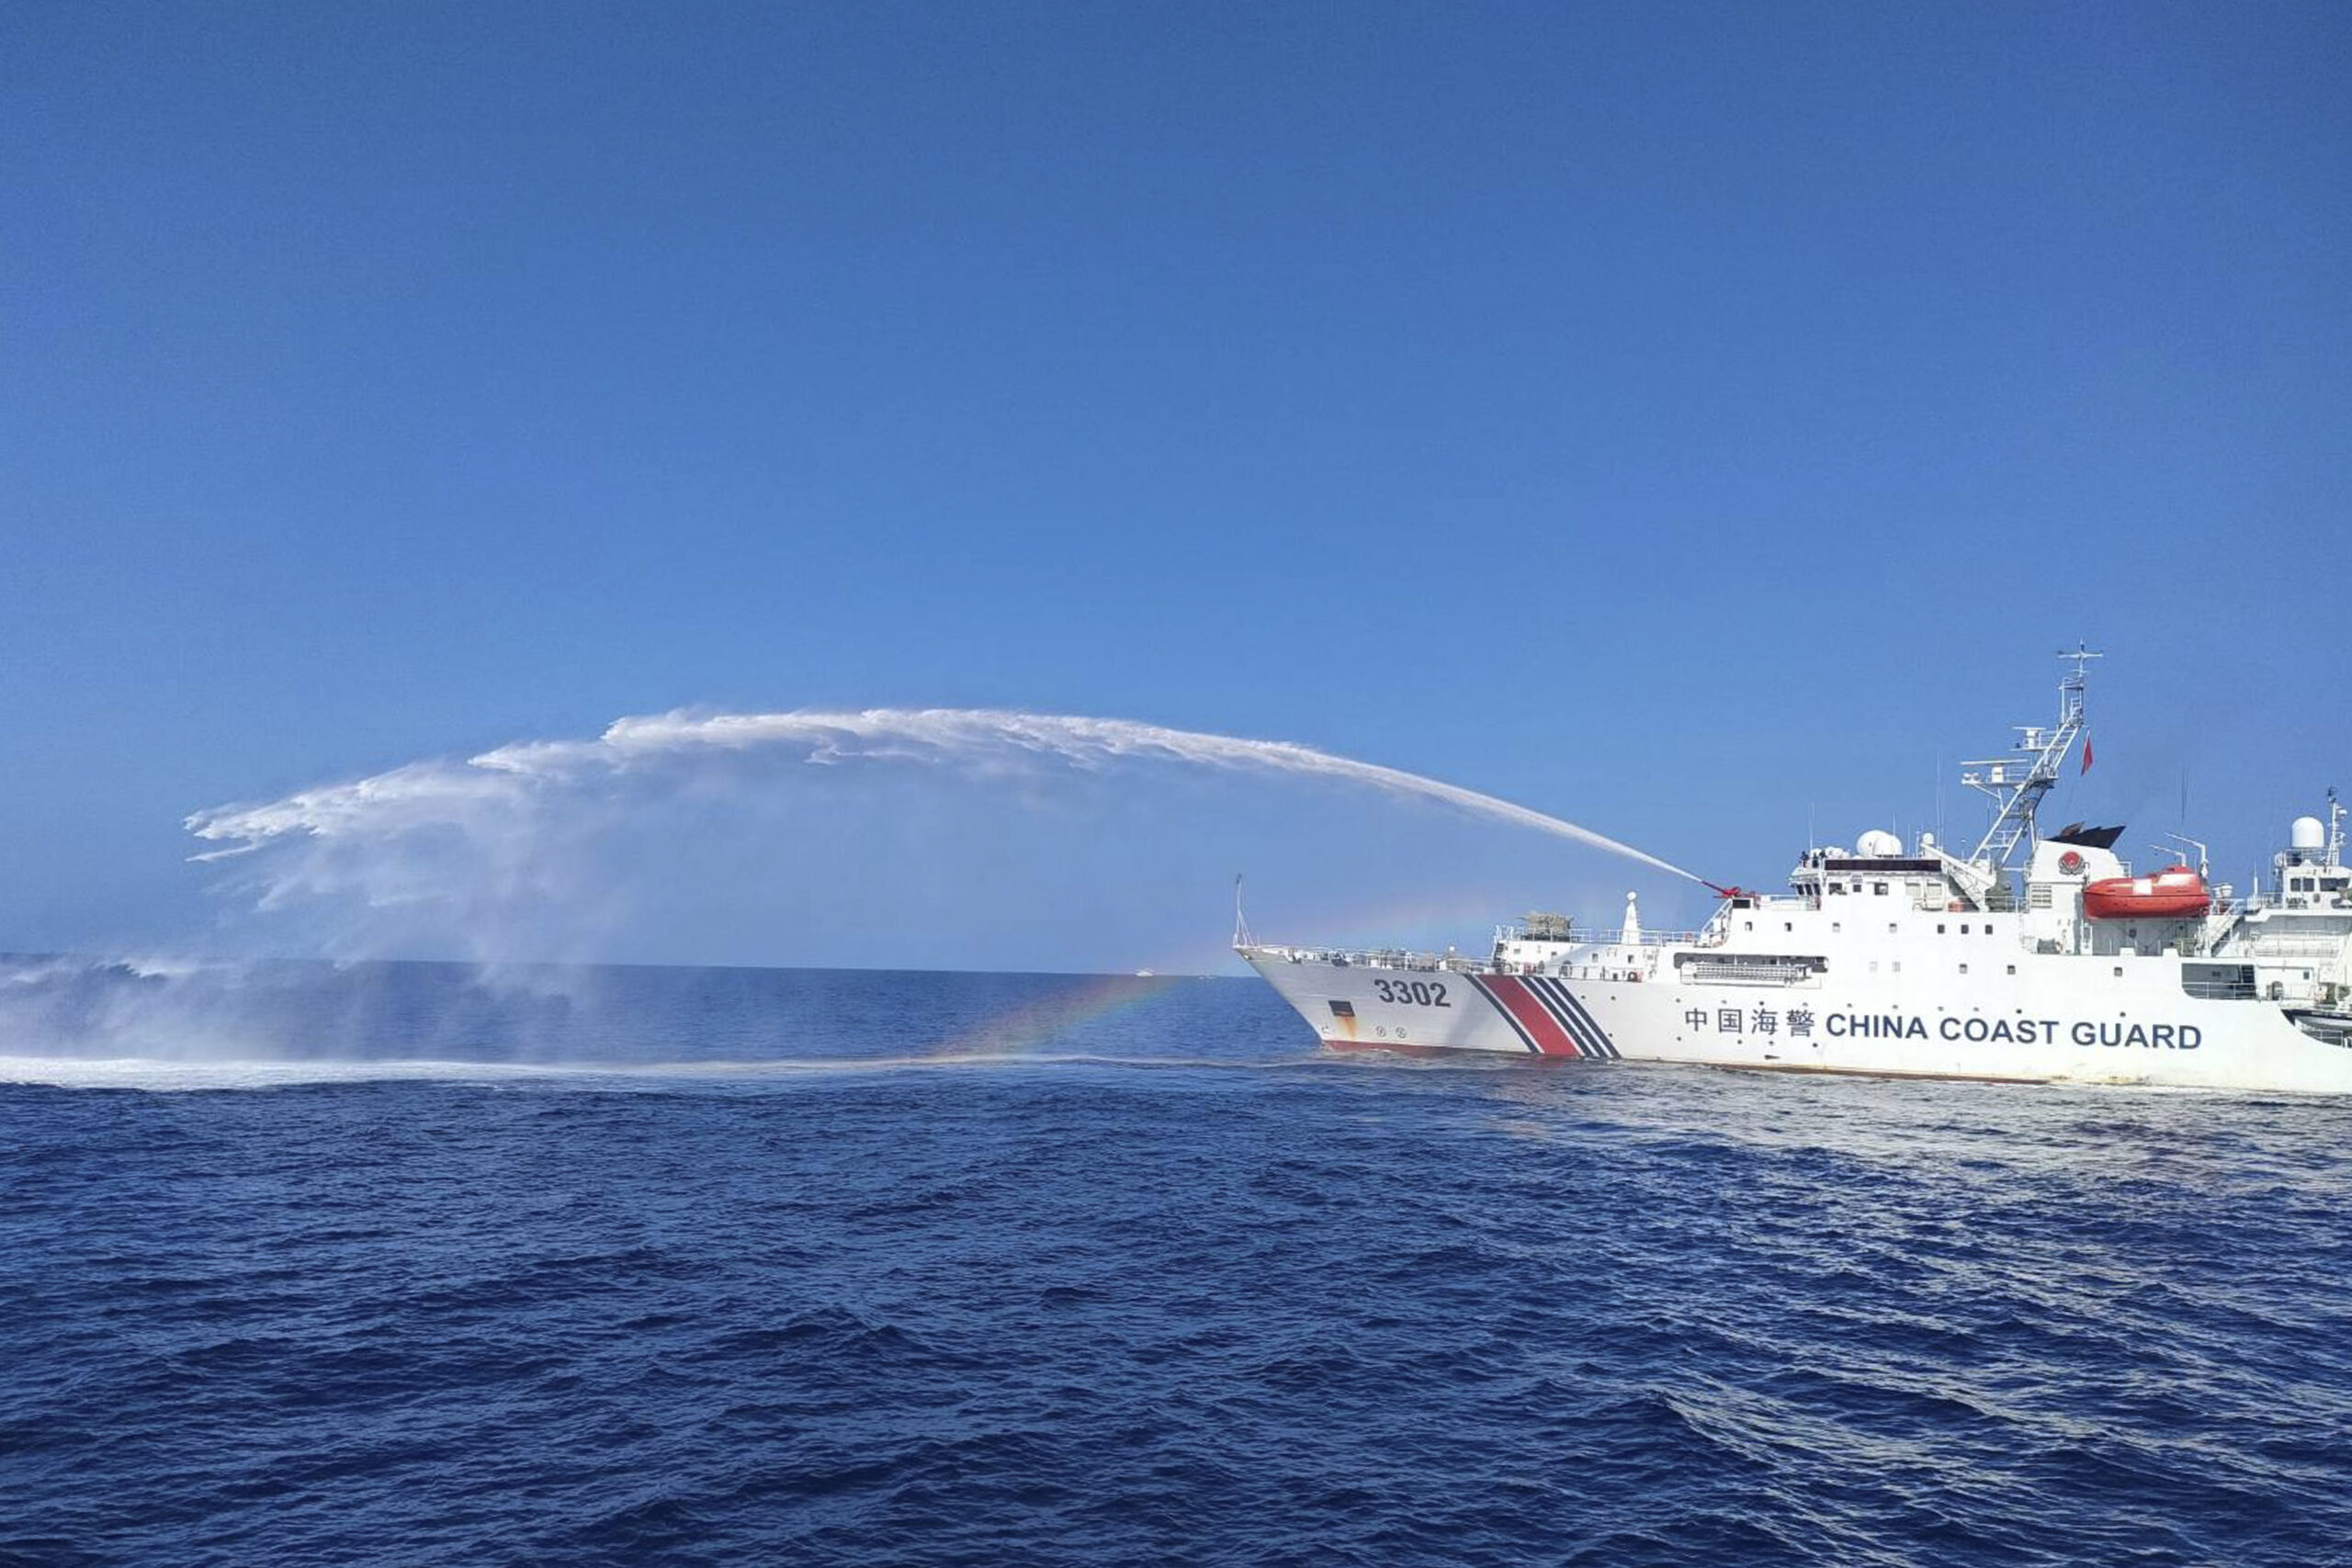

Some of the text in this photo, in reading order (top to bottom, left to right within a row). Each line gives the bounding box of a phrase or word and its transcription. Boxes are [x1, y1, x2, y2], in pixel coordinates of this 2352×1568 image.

[1374, 978, 1451, 1008] 3302
[1686, 1008, 1815, 1037] 中国海警
[1826, 1013, 2201, 1050] CHINA COAST GUARD
